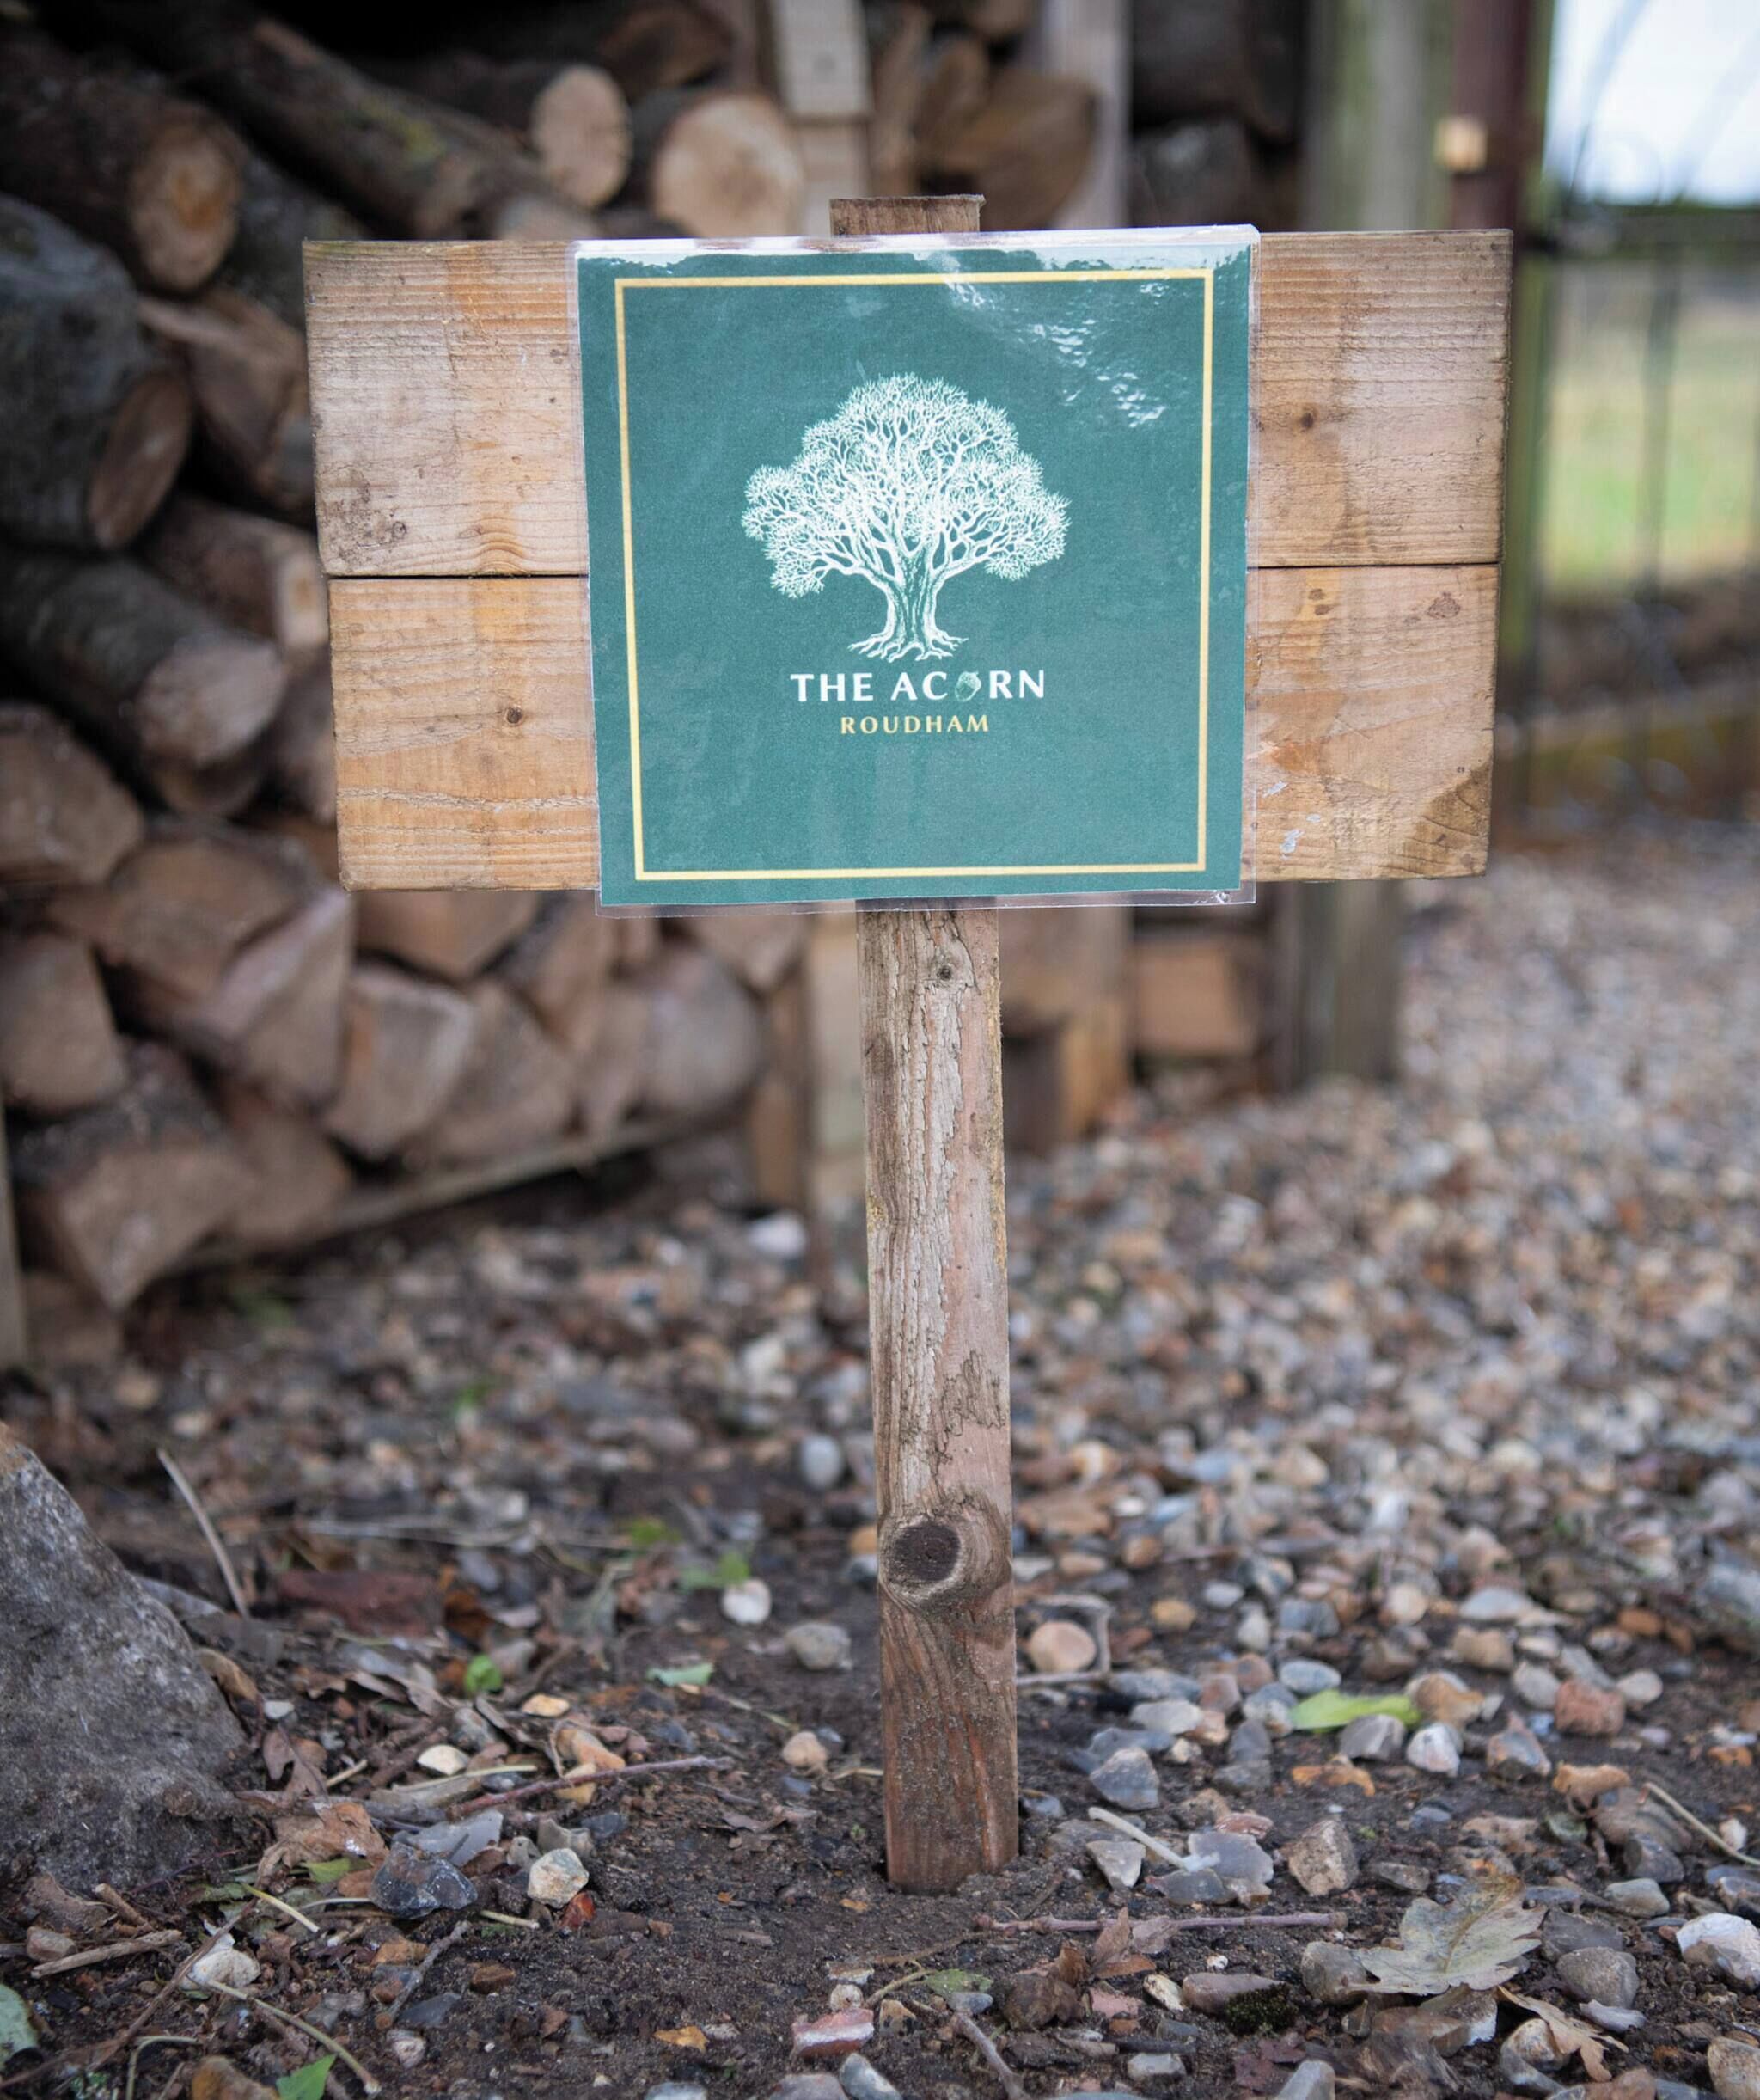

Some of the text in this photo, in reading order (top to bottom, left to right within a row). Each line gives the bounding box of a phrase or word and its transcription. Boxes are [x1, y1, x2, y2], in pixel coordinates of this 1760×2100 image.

[790, 670, 1044, 702] THE ACORN
[840, 714, 988, 734] ROUDHAM
